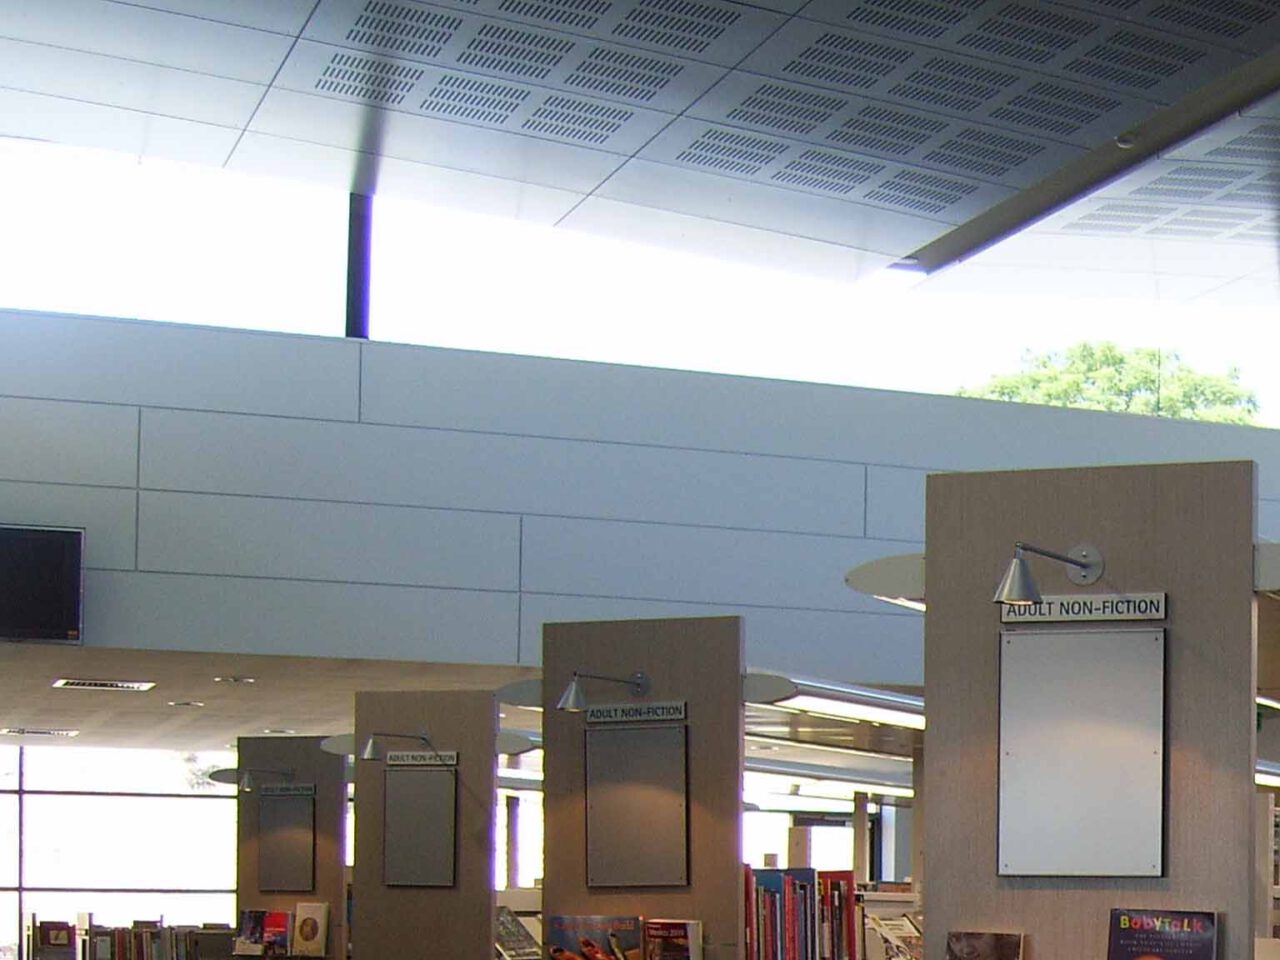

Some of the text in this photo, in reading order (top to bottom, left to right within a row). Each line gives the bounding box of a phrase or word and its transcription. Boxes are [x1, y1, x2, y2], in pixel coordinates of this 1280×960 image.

[1007, 600, 1160, 616] ADULT NON-FICTION
[589, 706, 682, 719] ADULT NON-FICTION
